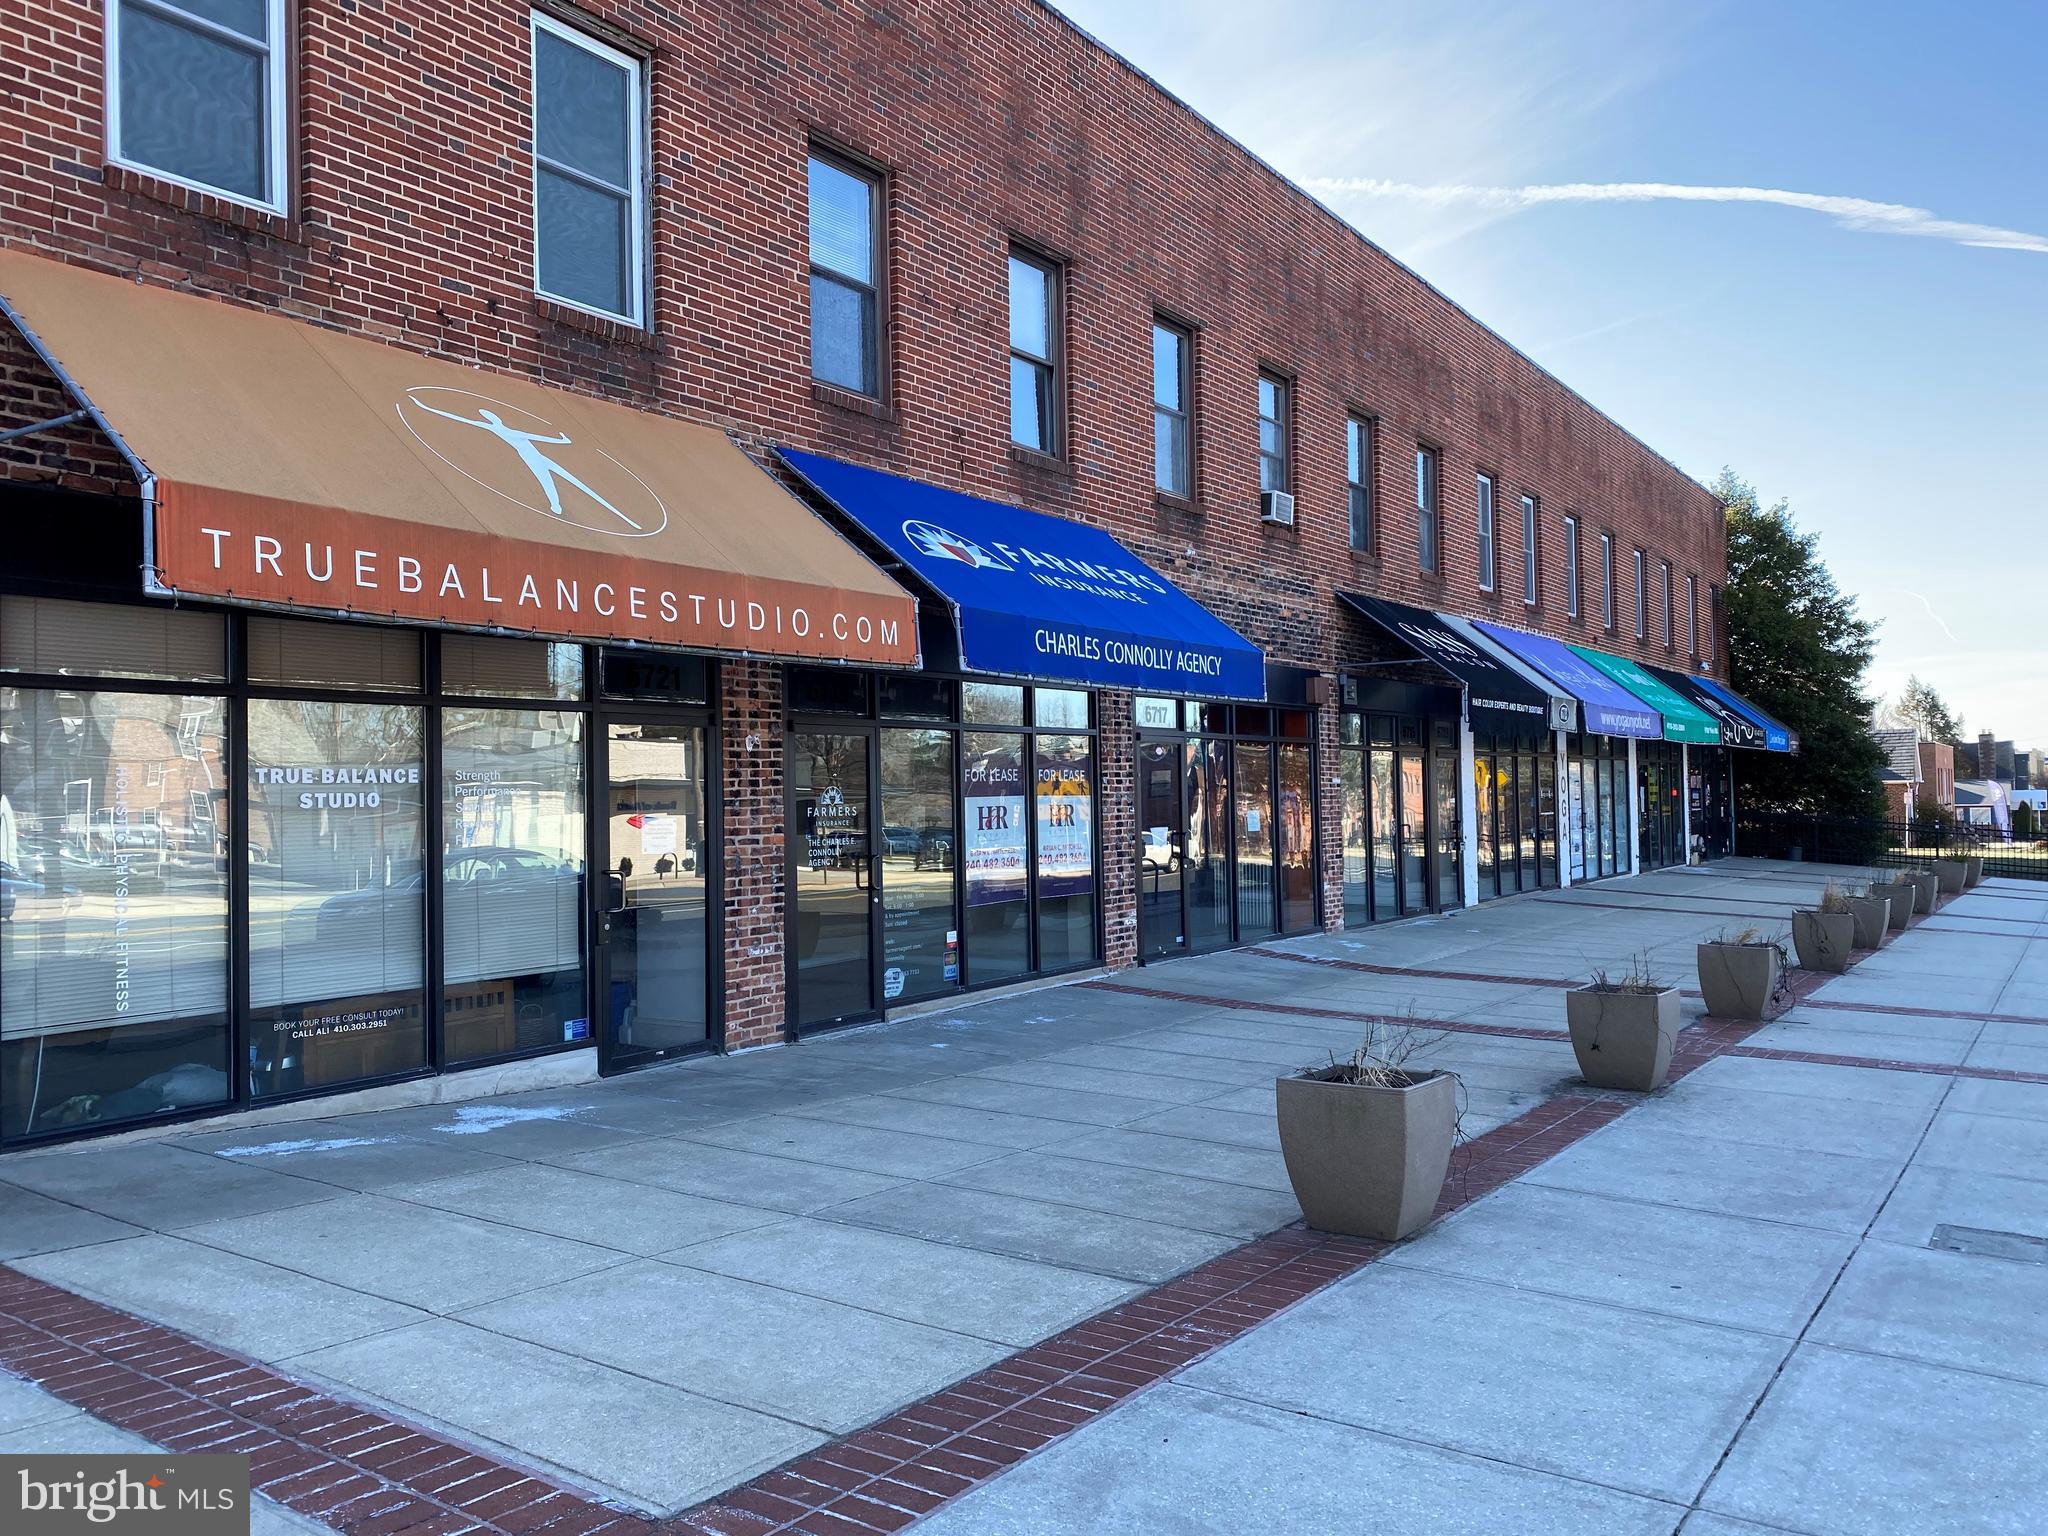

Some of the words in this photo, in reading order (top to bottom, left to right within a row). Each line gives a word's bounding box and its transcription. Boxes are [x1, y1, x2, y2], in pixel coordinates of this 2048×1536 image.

[991, 541, 1167, 594] FARMERS
[201, 527, 899, 647] TRUEBALANCESTUDIO.COM
[1029, 572, 1149, 604] INSURANCE
[1035, 629, 1100, 661] CHARLES
[1104, 640, 1173, 670] CONNOLLY
[1176, 650, 1222, 676] AGENCY
[1438, 651, 1498, 670] SALON
[1144, 705, 1168, 724] 6717
[1472, 698, 1481, 706] HAIR
[1482, 699, 1494, 708] COLOR
[1494, 700, 1509, 710] EXPERTS
[1517, 703, 1528, 713] BEAUTY
[1528, 705, 1544, 715] BOUTIQUE
[255, 767, 314, 784] TRUE
[321, 767, 419, 784] BALANCE
[455, 770, 501, 783] Strength
[964, 769, 986, 782] FOR
[989, 768, 1018, 782] LEASE
[1038, 769, 1056, 781] FOR
[1058, 769, 1086, 782] LEASE
[300, 792, 380, 809] STUDIO
[455, 786, 521, 797] Performance
[1559, 752, 1568, 840] YOGA
[115, 766, 128, 843] HOLISTIC
[807, 806, 858, 817] FARMERS
[808, 839, 821, 847] THE
[821, 837, 850, 846] CHARLES
[808, 847, 843, 857] CONNOLLY
[808, 858, 834, 867] AGENCY
[115, 854, 128, 936] PHYSICAL
[115, 942, 128, 1011] FITNESS
[273, 1020, 296, 1032] BOOK
[298, 1019, 319, 1028] YOUR
[321, 1015, 340, 1025] FREE
[342, 1011, 377, 1022] CONSULT
[378, 1008, 404, 1018] TODAY!
[292, 1030, 314, 1039] CALL
[315, 1027, 330, 1035] ALI
[333, 1019, 387, 1033] 410.303.2951
